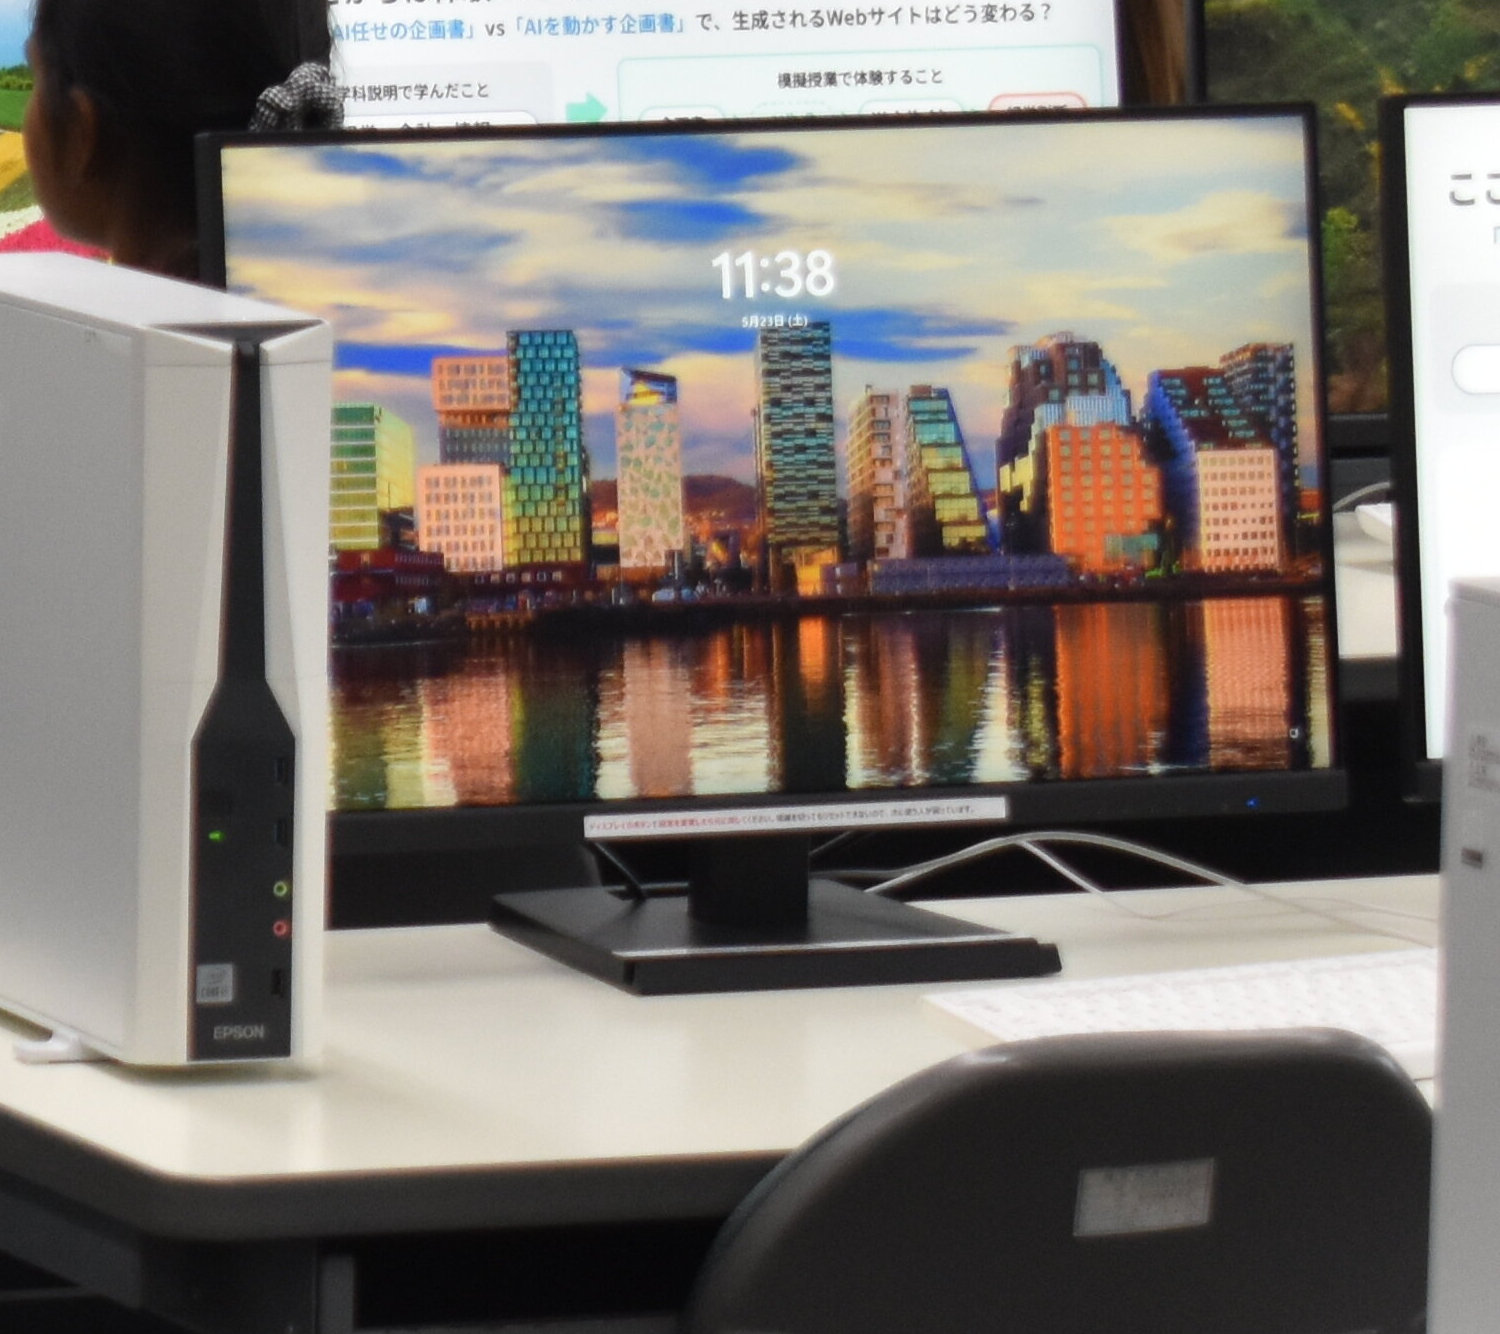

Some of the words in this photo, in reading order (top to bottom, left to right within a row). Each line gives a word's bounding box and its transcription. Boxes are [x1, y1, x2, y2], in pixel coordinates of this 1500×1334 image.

[333, 19, 476, 42] AI任せの企画書」
[485, 22, 506, 37] vs
[711, 249, 835, 299] 11:38
[213, 1025, 264, 1040] EPSON
